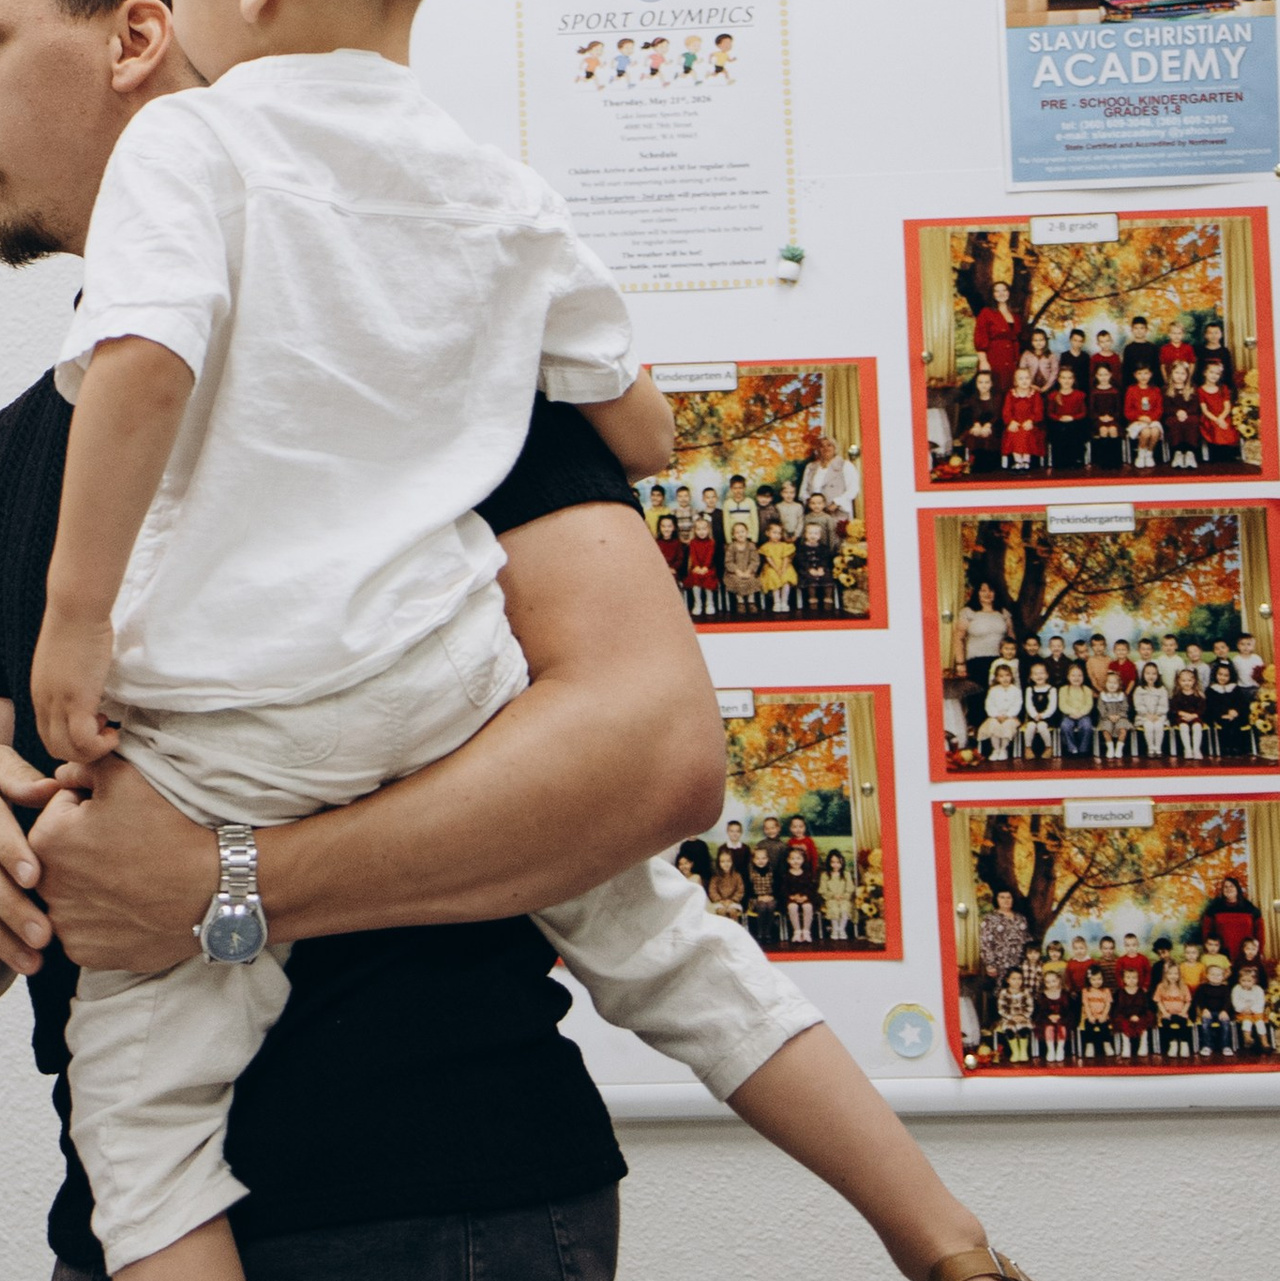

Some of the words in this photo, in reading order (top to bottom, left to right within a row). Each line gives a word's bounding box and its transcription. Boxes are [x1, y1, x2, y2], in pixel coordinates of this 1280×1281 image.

[558, 12, 634, 32] SPORT
[639, 6, 755, 27] OLYMPICS
[1028, 29, 1116, 53] SLAVIC
[1124, 22, 1253, 48] CHRISTIAN
[1032, 46, 1247, 88] ACADEMY
[603, 99, 646, 108] Thursday,
[649, 98, 667, 107] May
[1041, 99, 1067, 110] PRE
[1079, 97, 1134, 109] SCHOOL
[1138, 91, 1244, 106] KINDERGARTEN
[1104, 106, 1159, 118] GRADES
[1164, 105, 1182, 116] 1-8
[639, 150, 678, 159] Schedule
[568, 167, 601, 175] Children
[1069, 221, 1099, 233] grade
[655, 372, 722, 382] Kindergarten
[725, 371, 732, 379] A
[1050, 515, 1133, 525] Prekindergarten
[1082, 810, 1134, 821] Preschool
